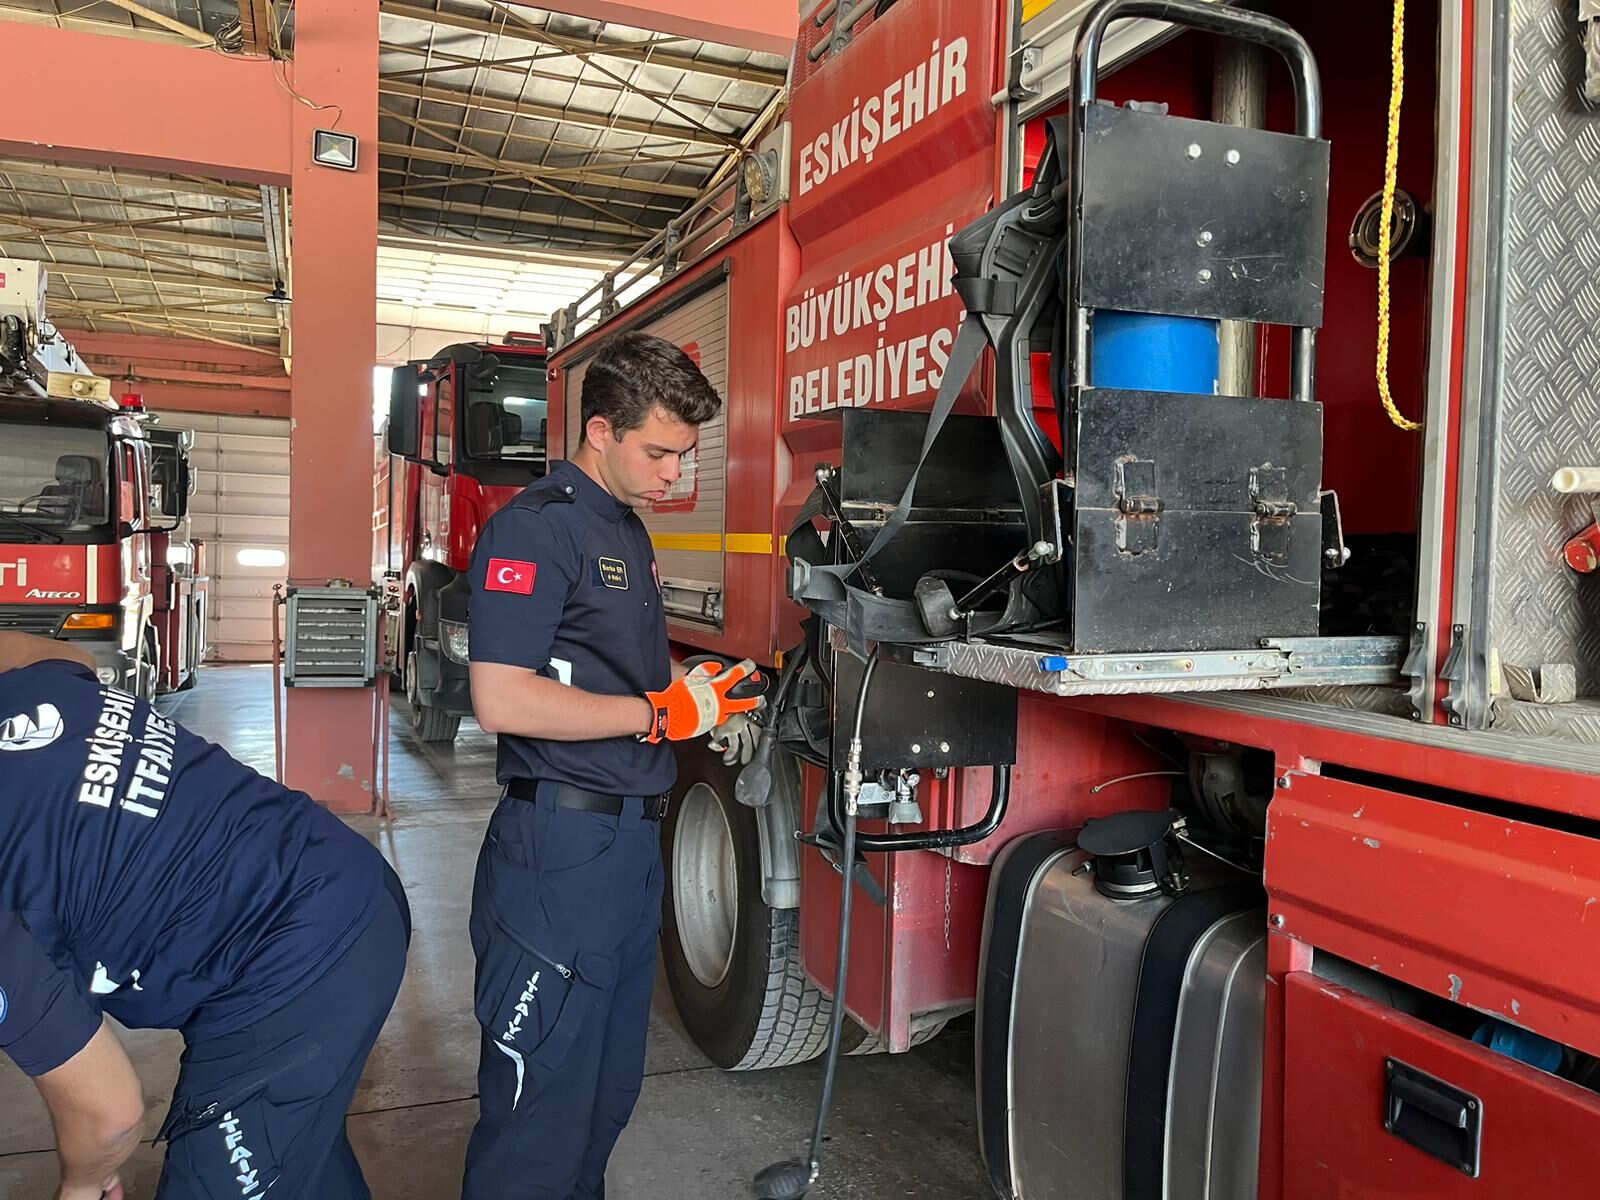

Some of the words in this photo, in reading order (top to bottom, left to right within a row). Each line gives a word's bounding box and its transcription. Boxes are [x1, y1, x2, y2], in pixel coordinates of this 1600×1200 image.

[799, 36, 968, 196] ESKİŞEHİR
[786, 222, 958, 353] BÜYÜKŞEHİ
[789, 310, 967, 422] BELEDİYES
